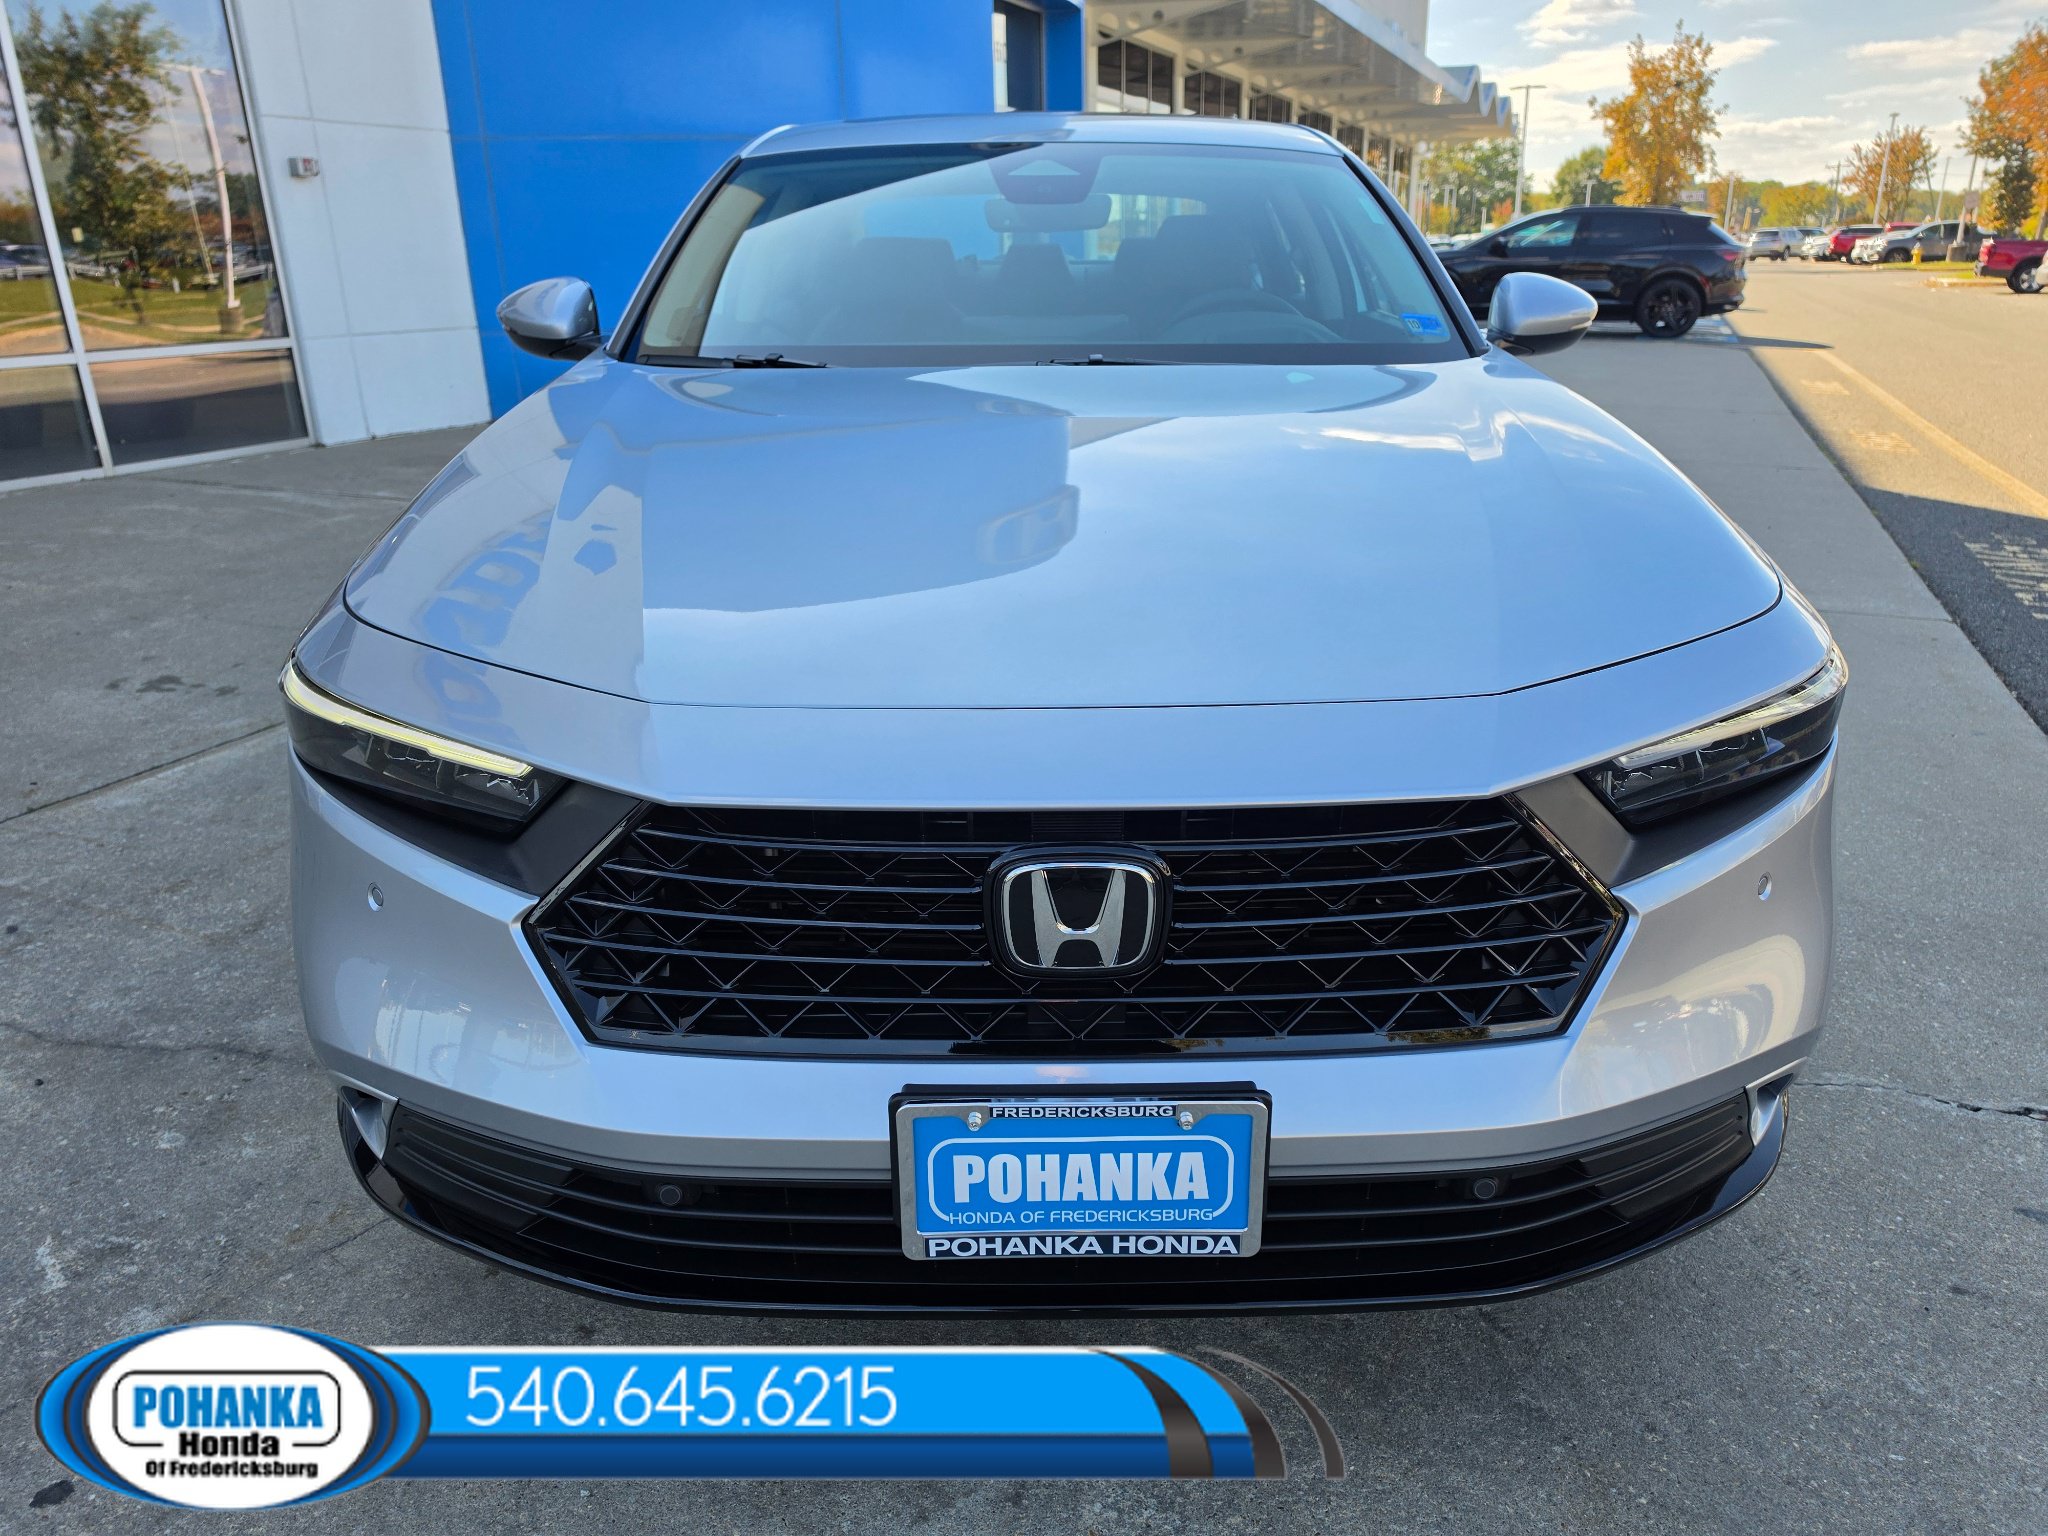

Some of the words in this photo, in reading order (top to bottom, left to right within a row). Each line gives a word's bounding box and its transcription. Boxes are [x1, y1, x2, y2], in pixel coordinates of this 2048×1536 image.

[992, 1106, 1174, 1118] FREDERICKSBURG
[952, 1151, 1210, 1204] POHANKA
[949, 1210, 1016, 1225] HONDA
[1020, 1210, 1046, 1224] OF
[1050, 1208, 1214, 1224] FREDERICKSBURG
[928, 1236, 1103, 1257] POHANKA
[1112, 1235, 1239, 1255] HONDA
